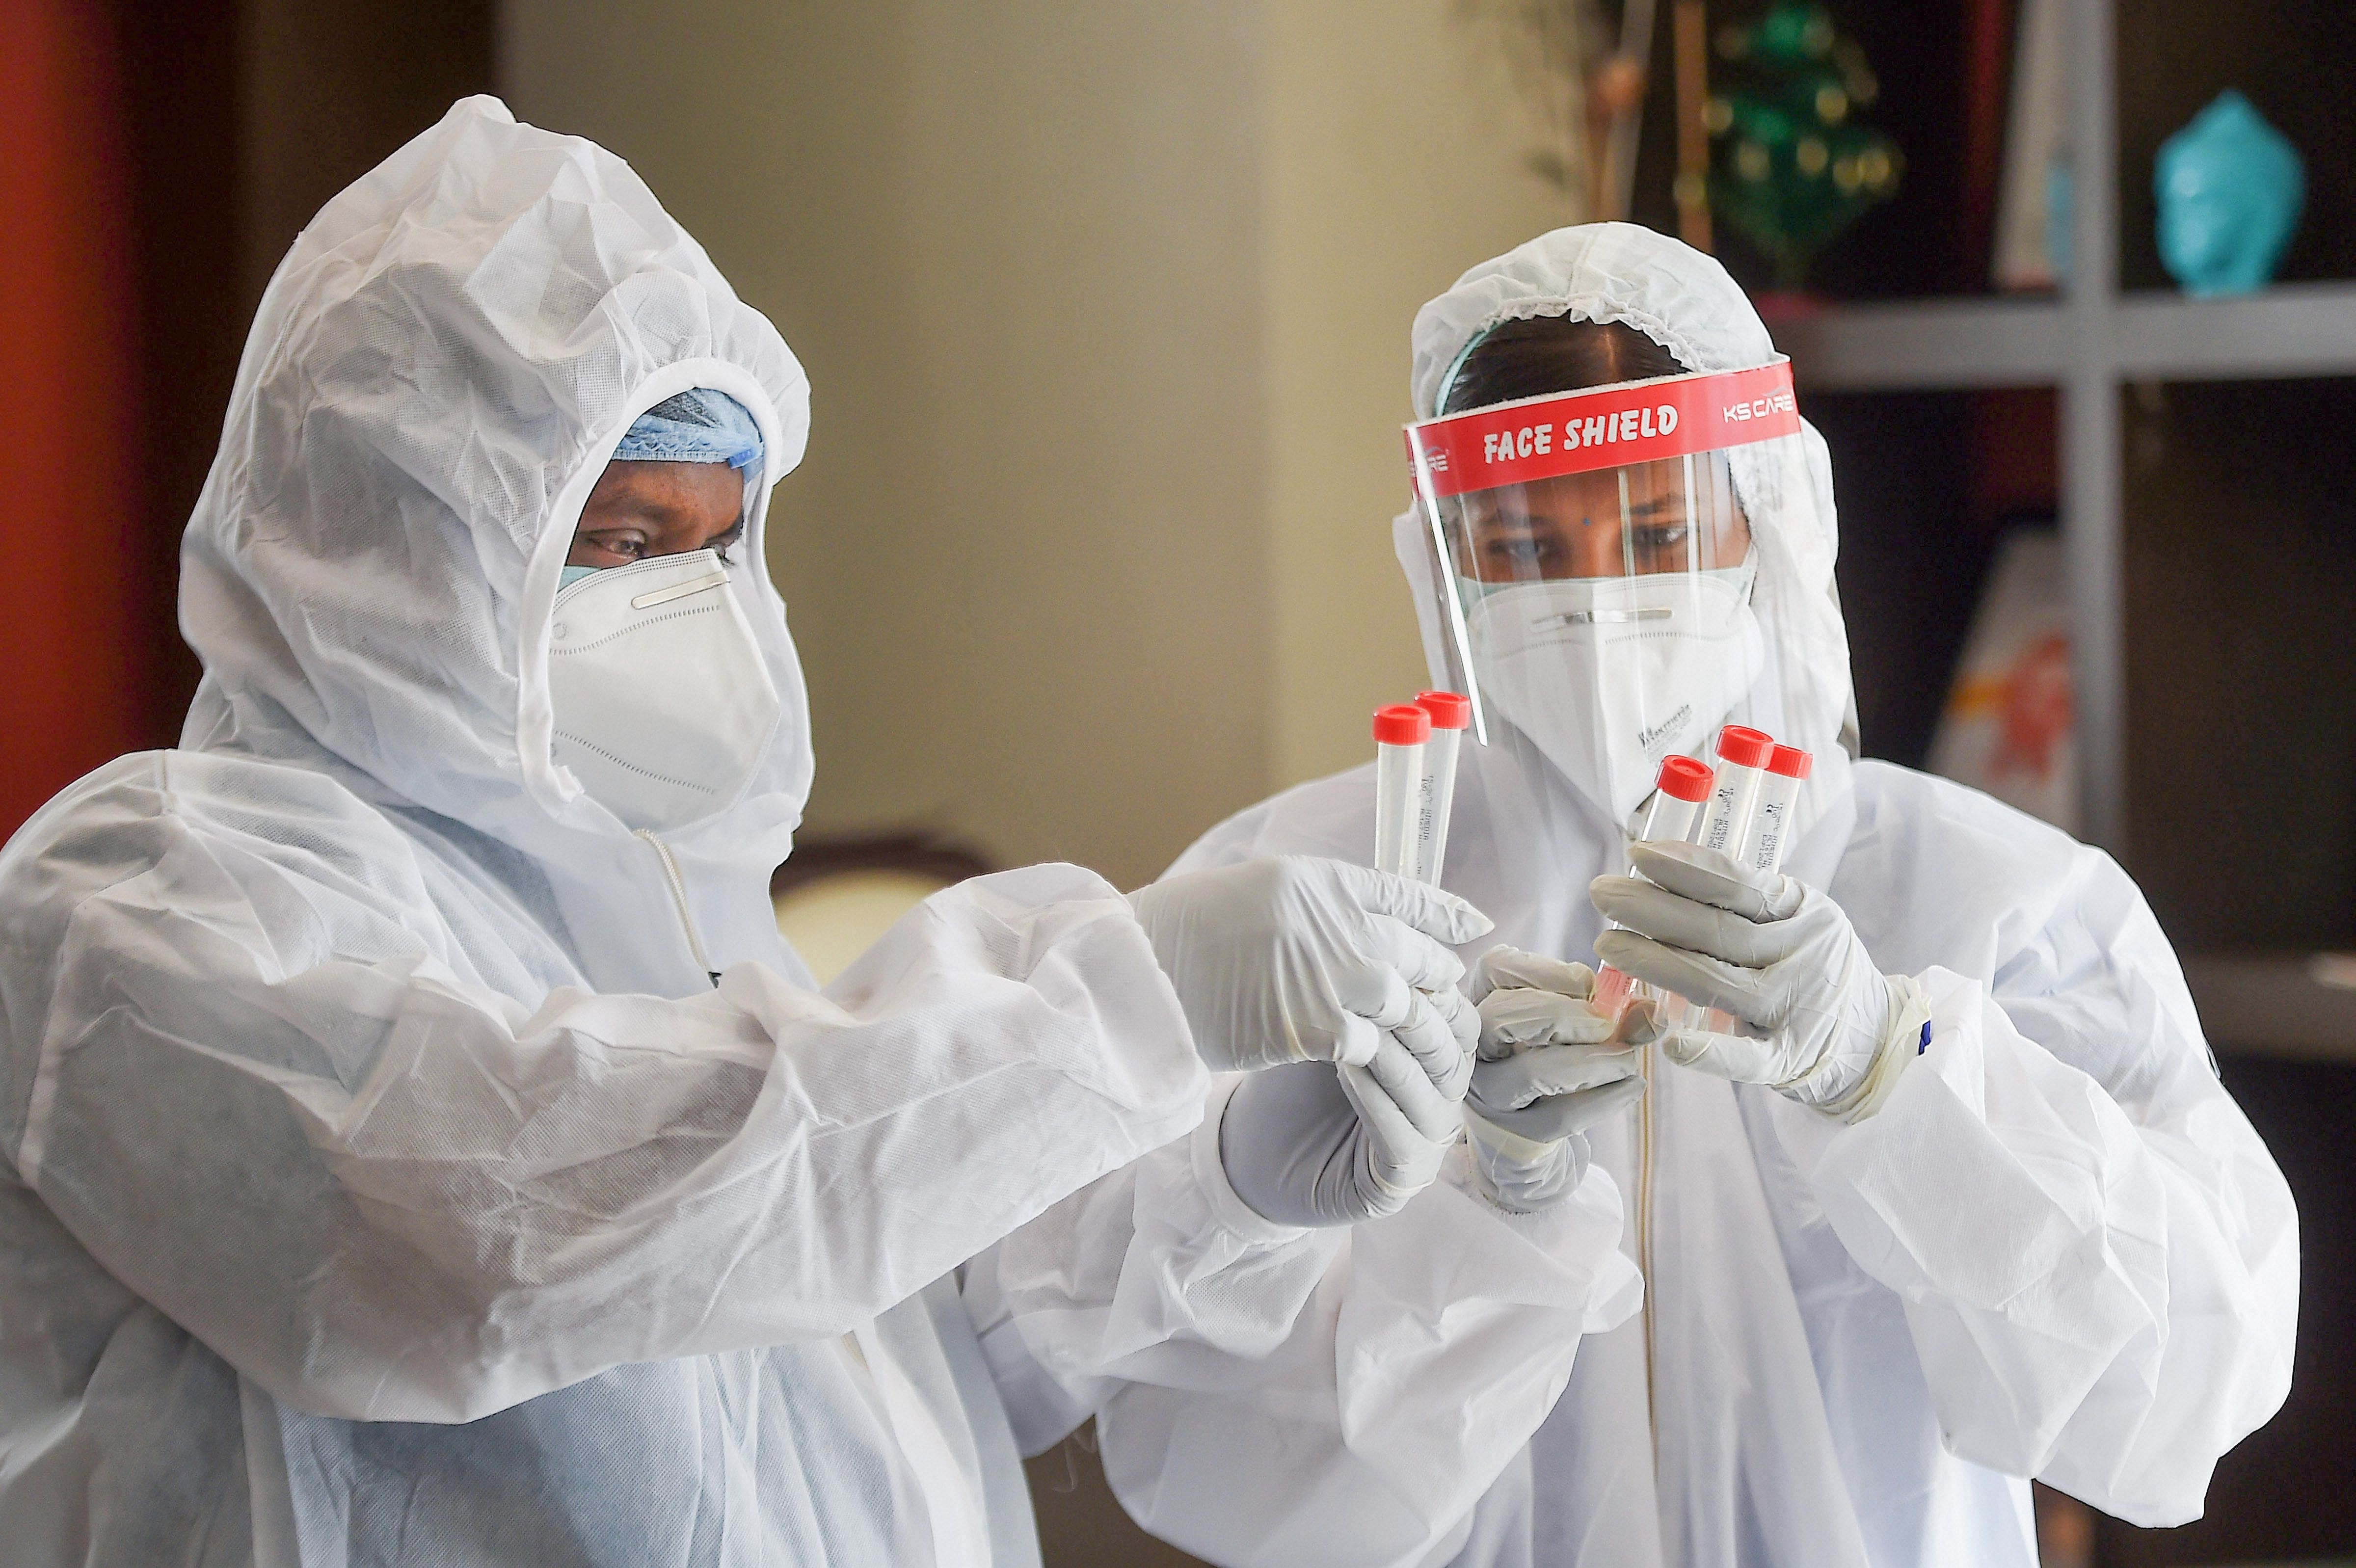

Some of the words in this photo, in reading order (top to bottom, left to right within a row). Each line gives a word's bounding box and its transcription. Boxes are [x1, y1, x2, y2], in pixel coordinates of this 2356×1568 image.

[1722, 402, 1752, 423] KS
[1752, 394, 1794, 418] CARE
[1484, 424, 1553, 464] FACE
[1563, 405, 1678, 451] SHIELD
